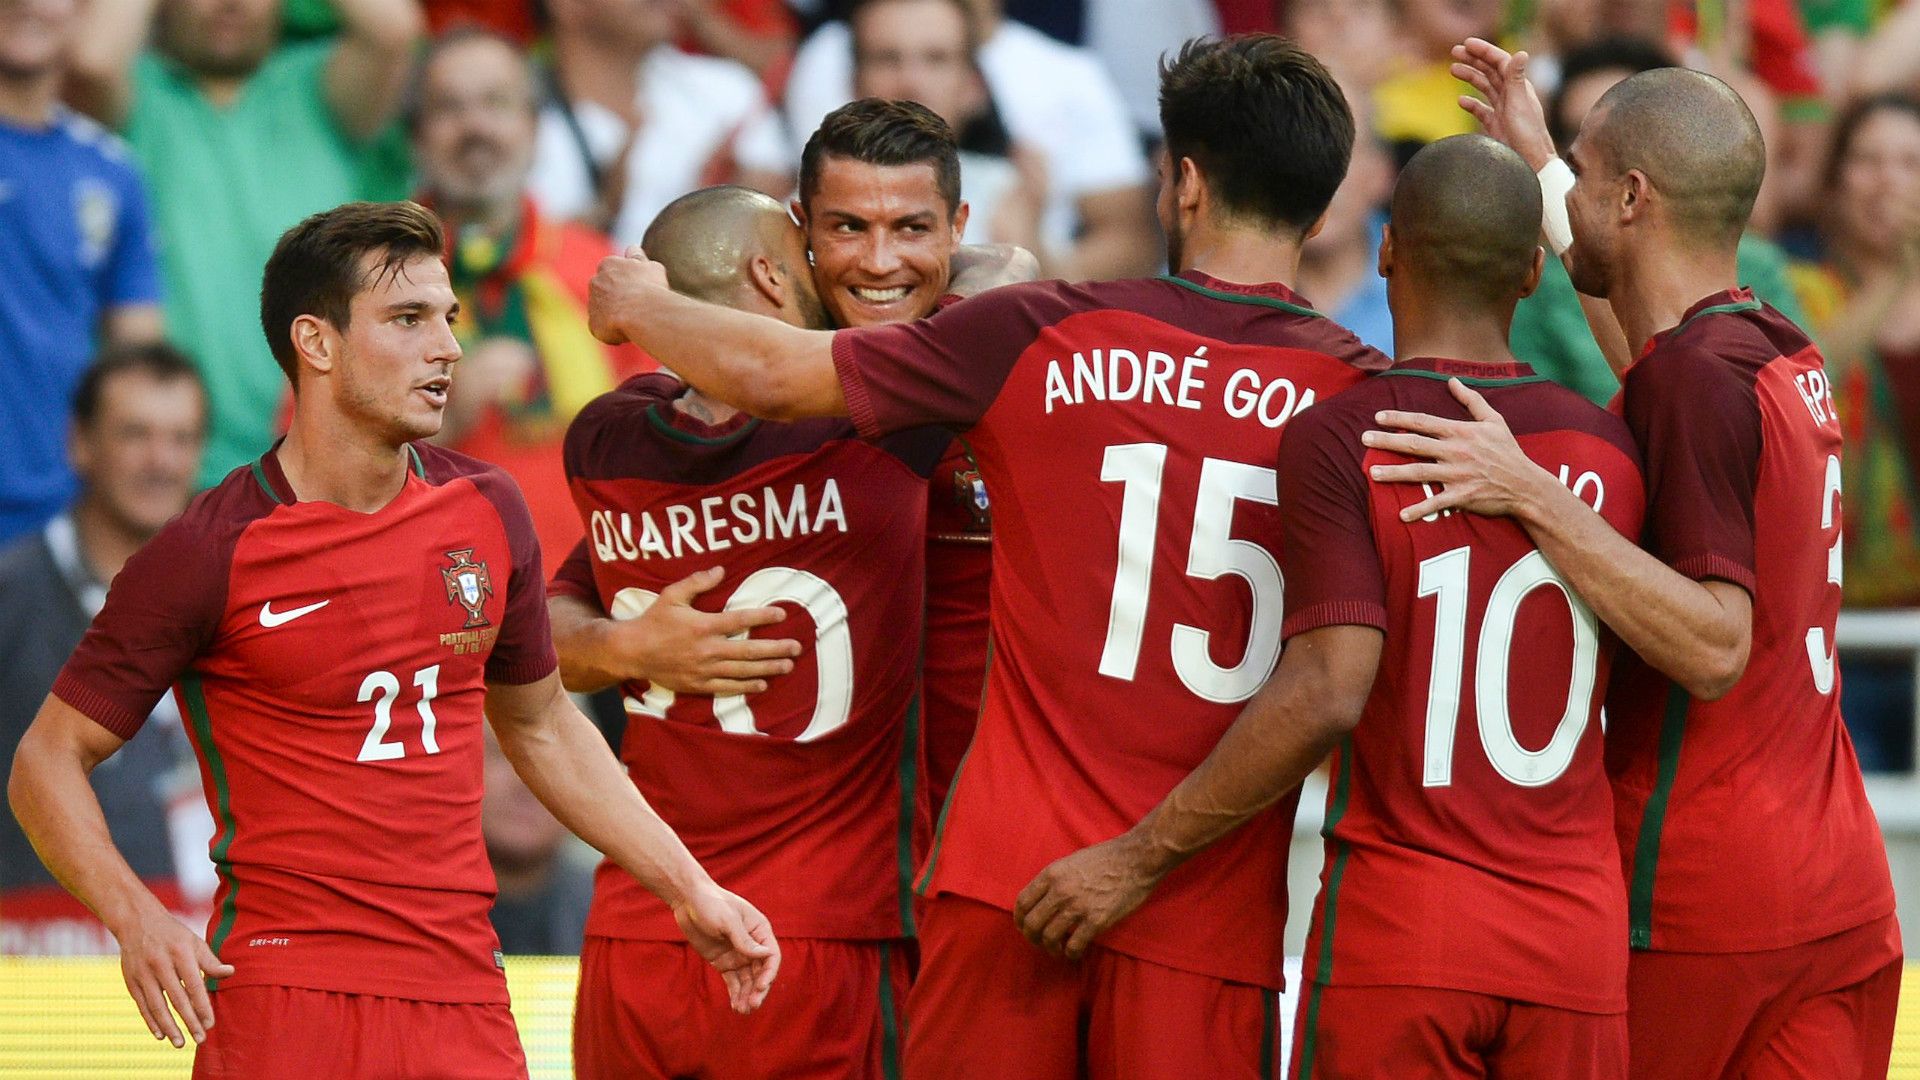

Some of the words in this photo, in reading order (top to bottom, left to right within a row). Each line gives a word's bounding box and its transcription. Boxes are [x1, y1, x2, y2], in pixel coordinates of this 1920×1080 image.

[1045, 346, 1209, 414] ANDRÉ
[1442, 361, 1509, 377] PORTUGAL
[590, 478, 848, 563] QUARESMA
[1098, 442, 1285, 704] 15
[1417, 545, 1600, 788] 10
[356, 664, 440, 762] 21
[248, 937, 290, 948] DRI-FIT
